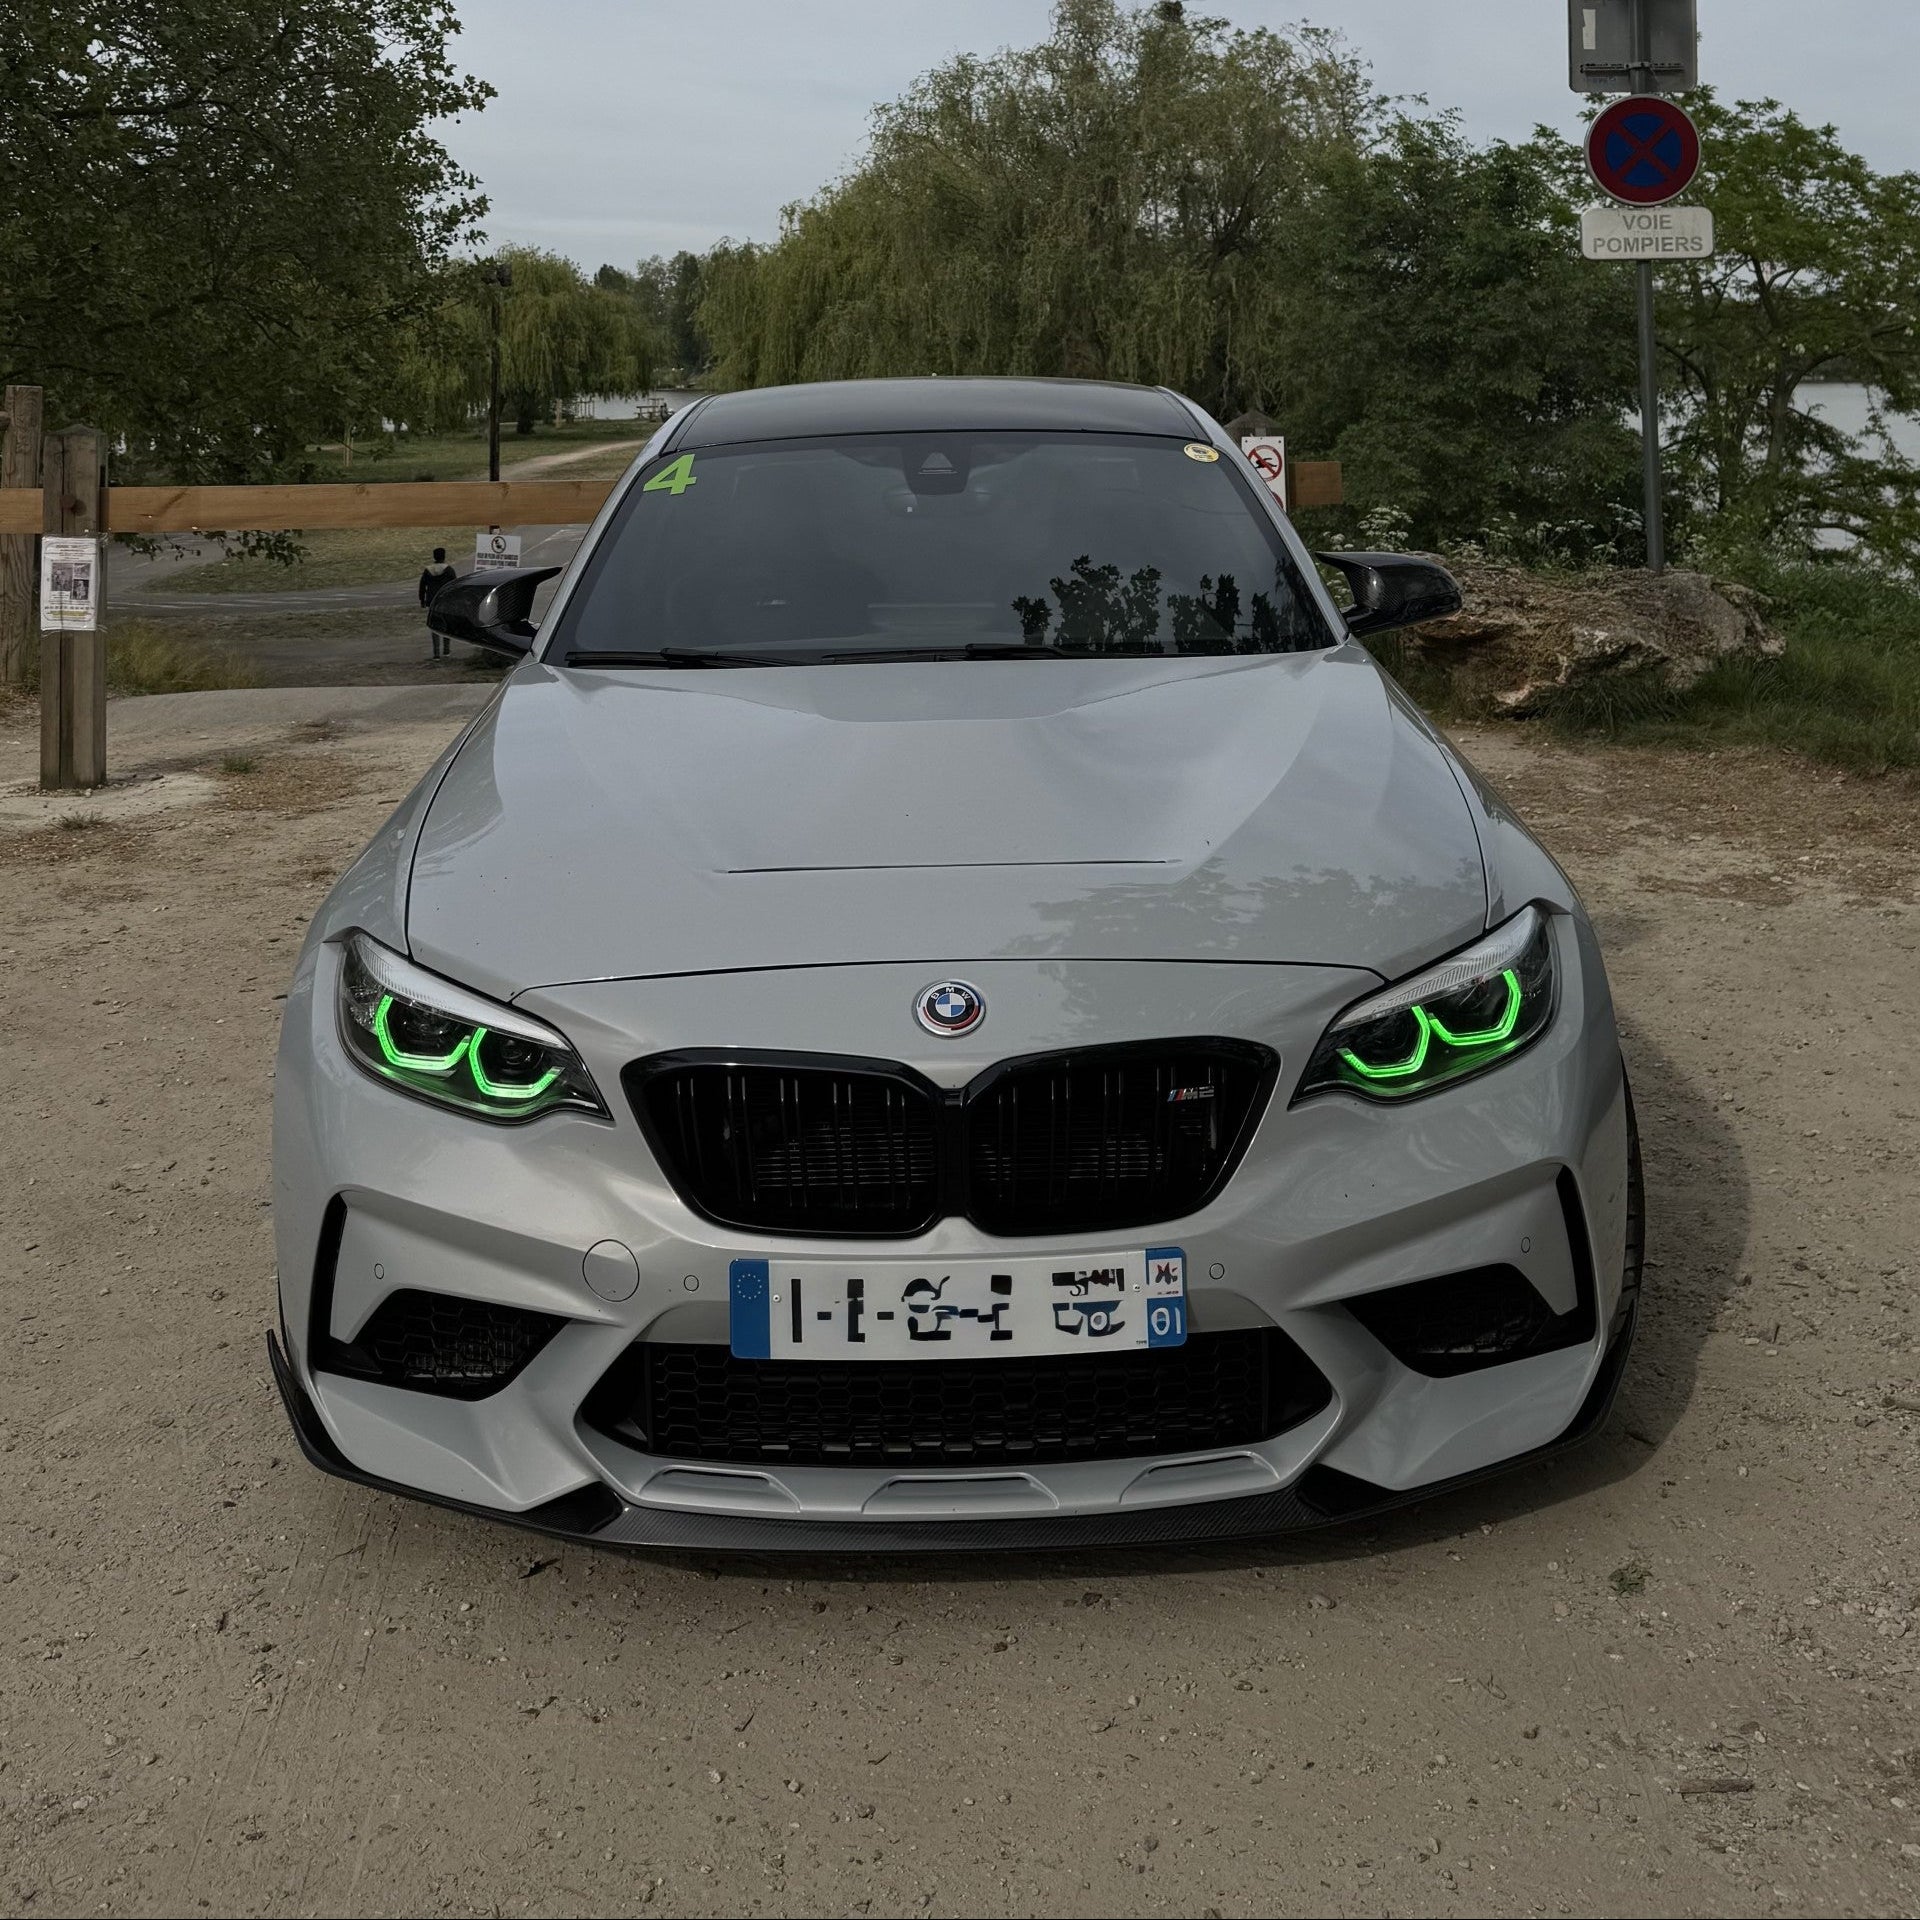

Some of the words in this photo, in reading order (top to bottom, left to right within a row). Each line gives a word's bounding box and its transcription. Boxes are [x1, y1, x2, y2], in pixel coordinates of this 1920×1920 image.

[1622, 214, 1673, 230] VOIE
[1592, 236, 1703, 253] POMPIERS
[643, 453, 697, 495] 4
[931, 987, 971, 1000] BMW
